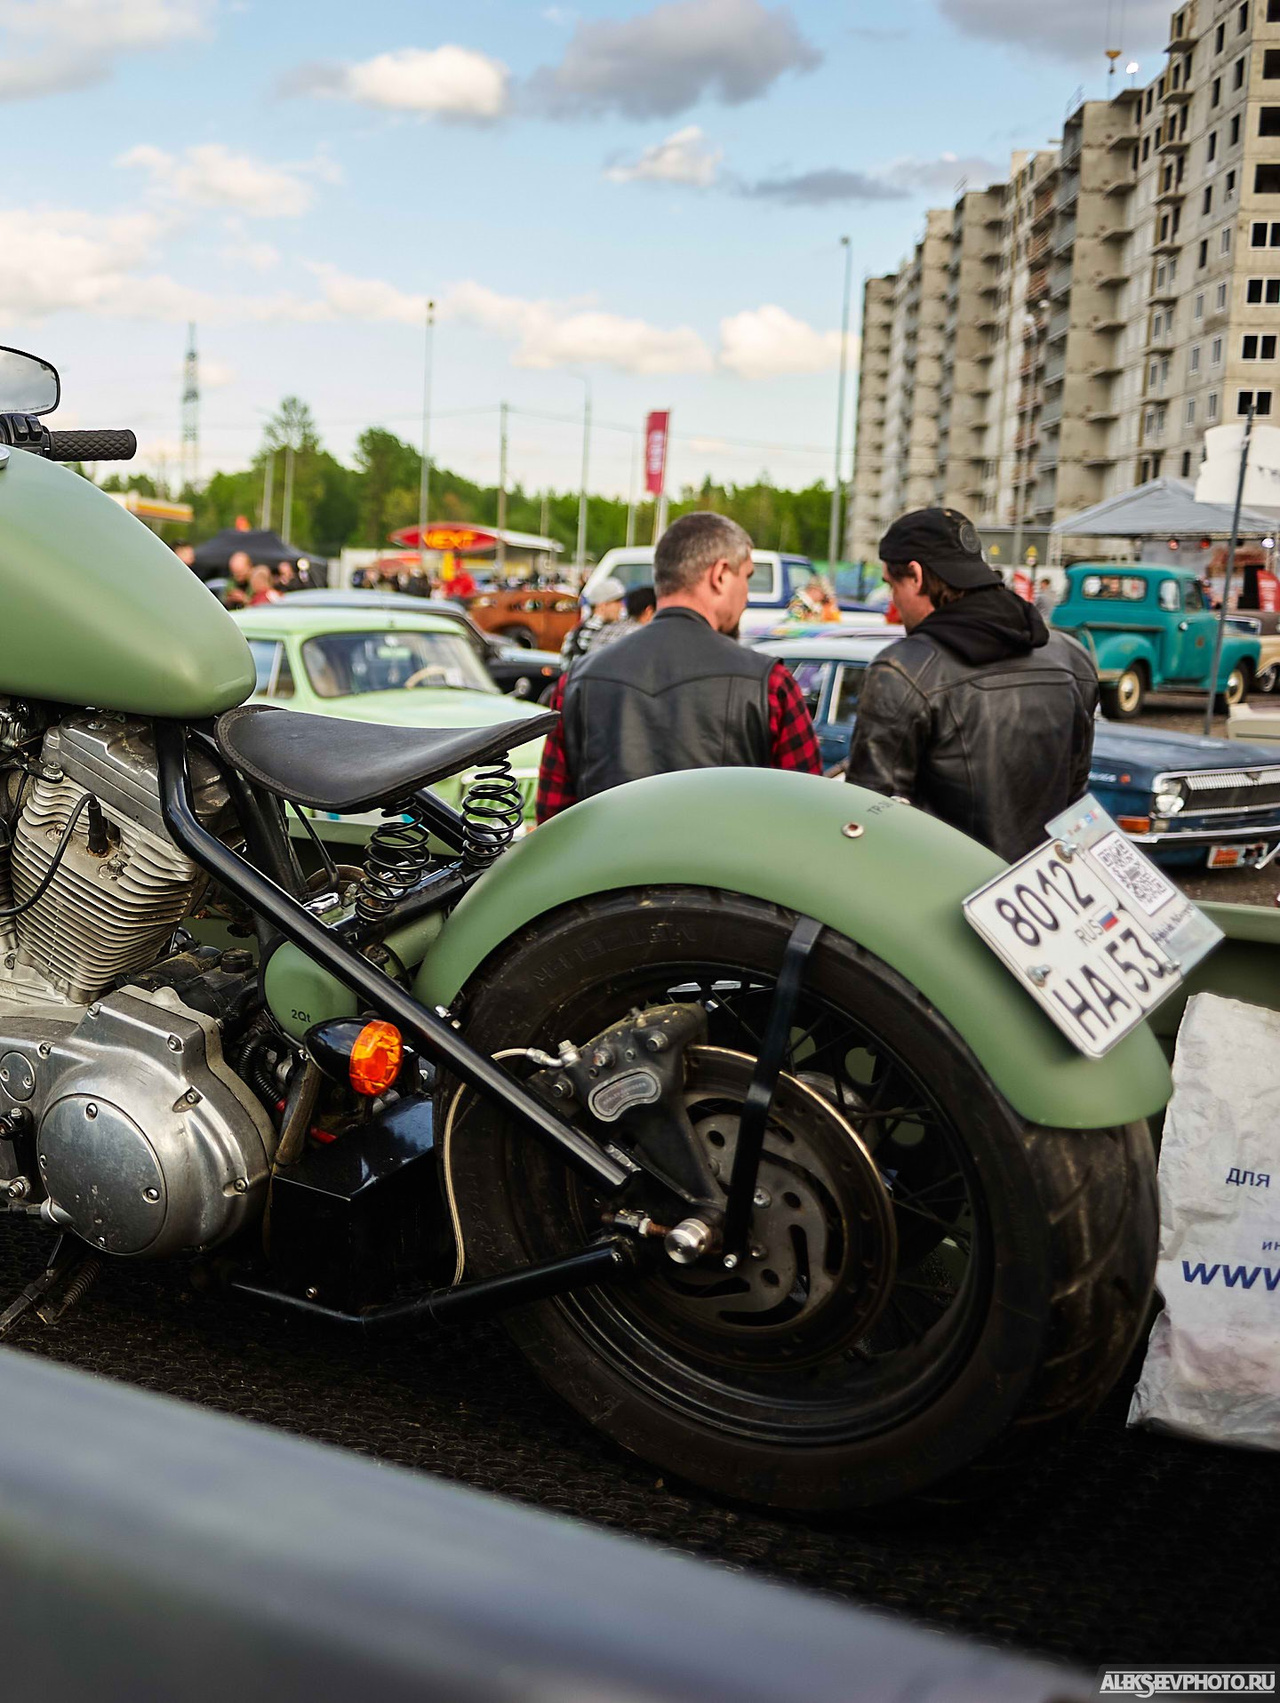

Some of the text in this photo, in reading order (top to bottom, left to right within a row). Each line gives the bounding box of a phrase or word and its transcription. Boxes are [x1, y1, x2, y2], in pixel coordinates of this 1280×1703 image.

[994, 859, 1095, 947] 8012
[1074, 919, 1105, 947] RUS
[1104, 927, 1165, 993] 53
[1225, 1167, 1271, 1188] для
